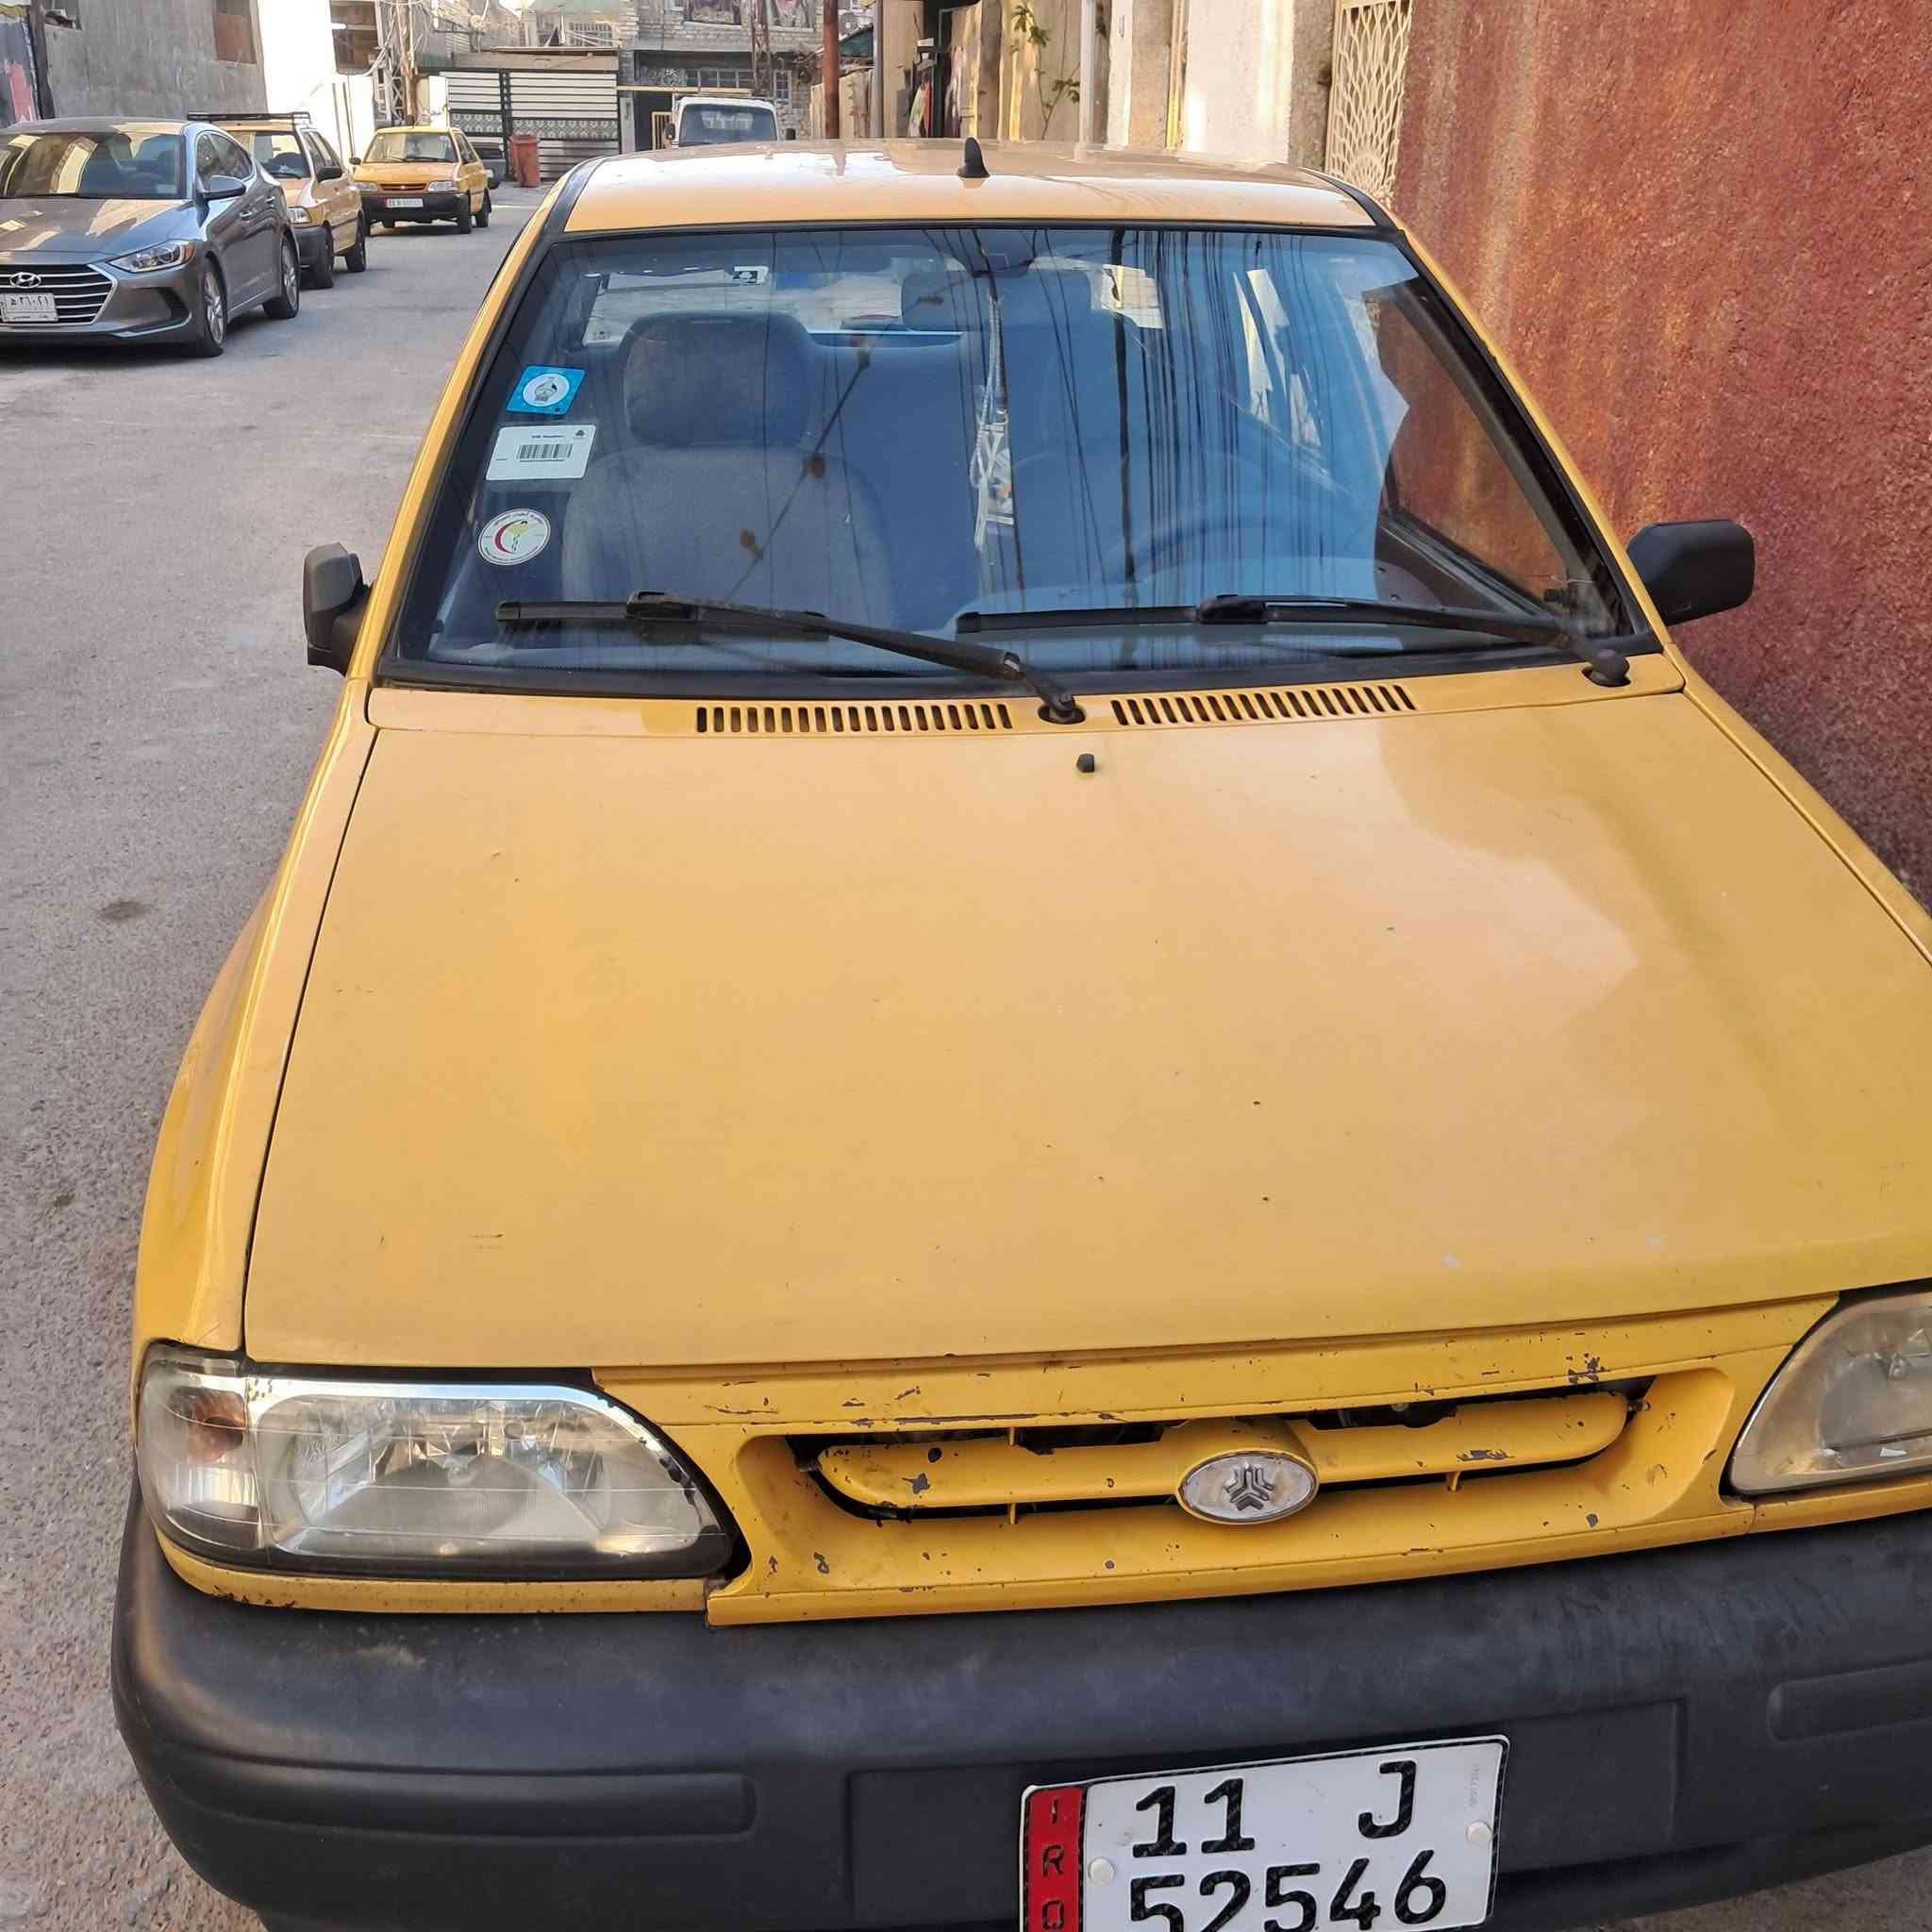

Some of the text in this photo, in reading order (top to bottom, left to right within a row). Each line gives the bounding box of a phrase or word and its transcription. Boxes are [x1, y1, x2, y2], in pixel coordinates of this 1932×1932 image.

[1132, 1778, 1256, 1858] 11
[1357, 1760, 1417, 1840] J
[1130, 1849, 1447, 1932] 52546
